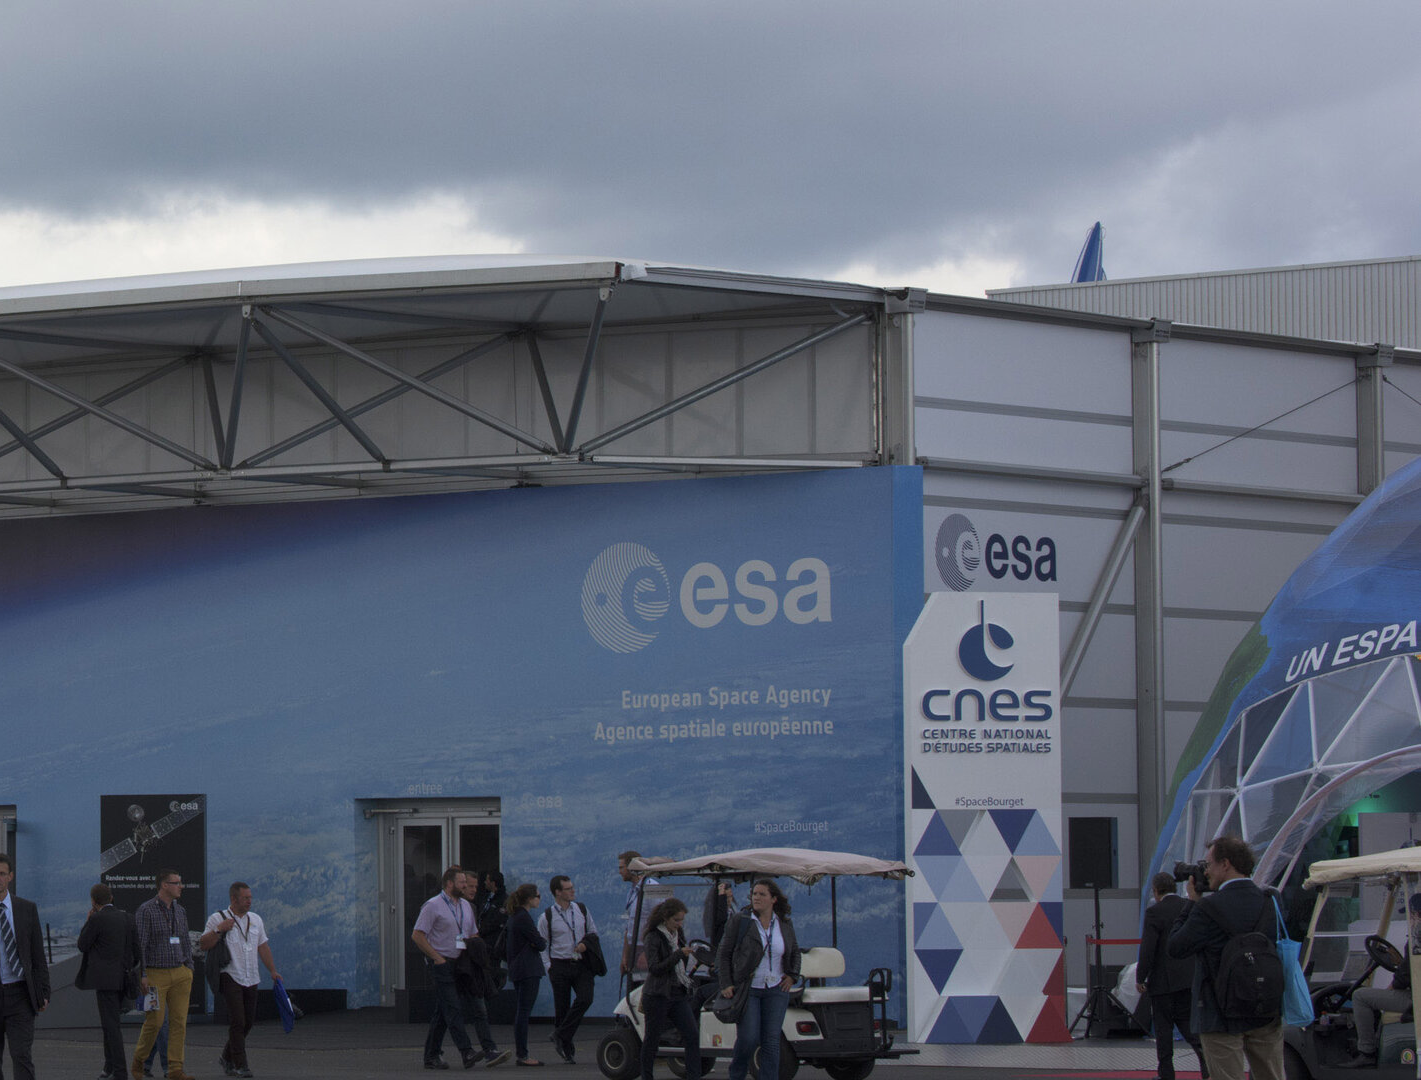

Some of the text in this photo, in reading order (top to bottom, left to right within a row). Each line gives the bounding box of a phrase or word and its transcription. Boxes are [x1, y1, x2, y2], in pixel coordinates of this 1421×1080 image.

[984, 533, 1057, 582] esa
[680, 557, 832, 628] esa
[1285, 620, 1417, 682] UN ESPA
[621, 685, 832, 711] European Space Agency
[922, 688, 1053, 722] cnes
[594, 716, 834, 745] Agence spatiale européenne
[922, 728, 1052, 740] CENTRE NATIONAL
[922, 740, 1052, 754] D'ÉTUDES SPATIALES
[180, 802, 199, 811] esa
[955, 797, 1024, 808] #SpaceBourget
[754, 820, 829, 835] #SpaceBourget
